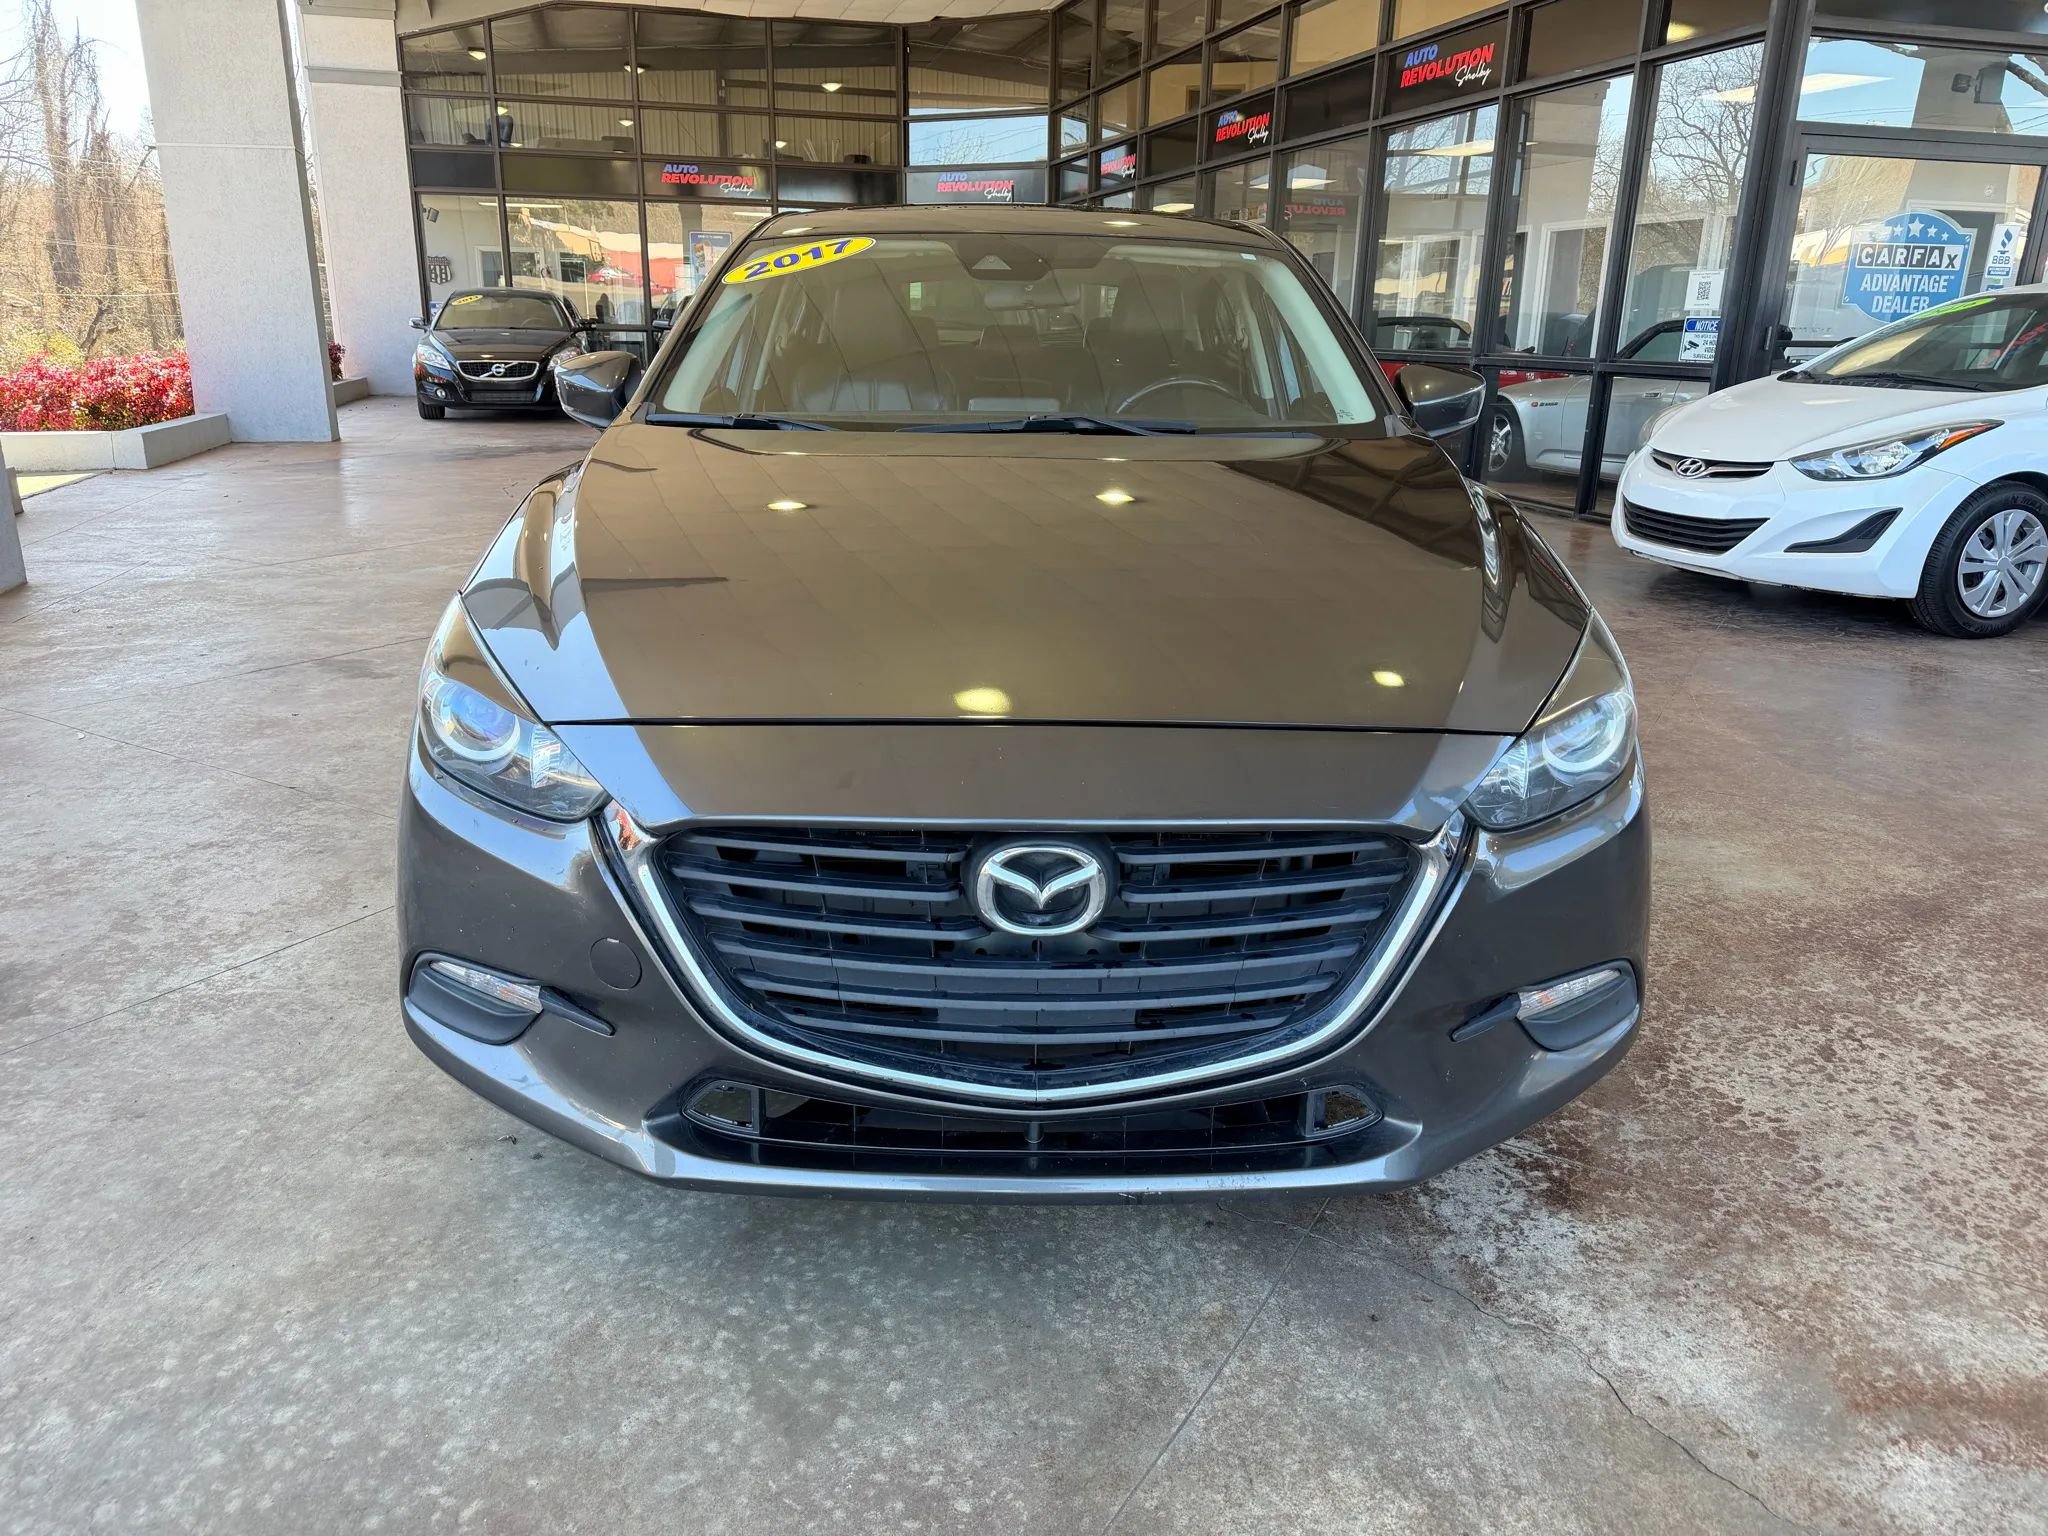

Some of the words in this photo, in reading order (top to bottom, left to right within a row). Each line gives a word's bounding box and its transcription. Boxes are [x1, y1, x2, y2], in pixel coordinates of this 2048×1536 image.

[1404, 44, 1438, 68] AUTO
[1400, 43, 1495, 88] REVOLUTION
[1455, 60, 1492, 87] Shelby
[1215, 112, 1271, 143] REVOLUTION
[1218, 110, 1239, 127] AUTO
[663, 163, 698, 173] AUTO
[939, 172, 967, 182] AUTO
[661, 173, 753, 186] REVOLUTION
[937, 180, 1014, 193] REVOLUTION
[744, 240, 852, 279] 2017
[1861, 247, 1959, 269] CARFAX
[1992, 255, 2011, 265] BBB
[1860, 273, 1949, 293] ADVANTAGE
[1872, 295, 1929, 313] DEALER
[1694, 319, 1719, 331] NOTICE
